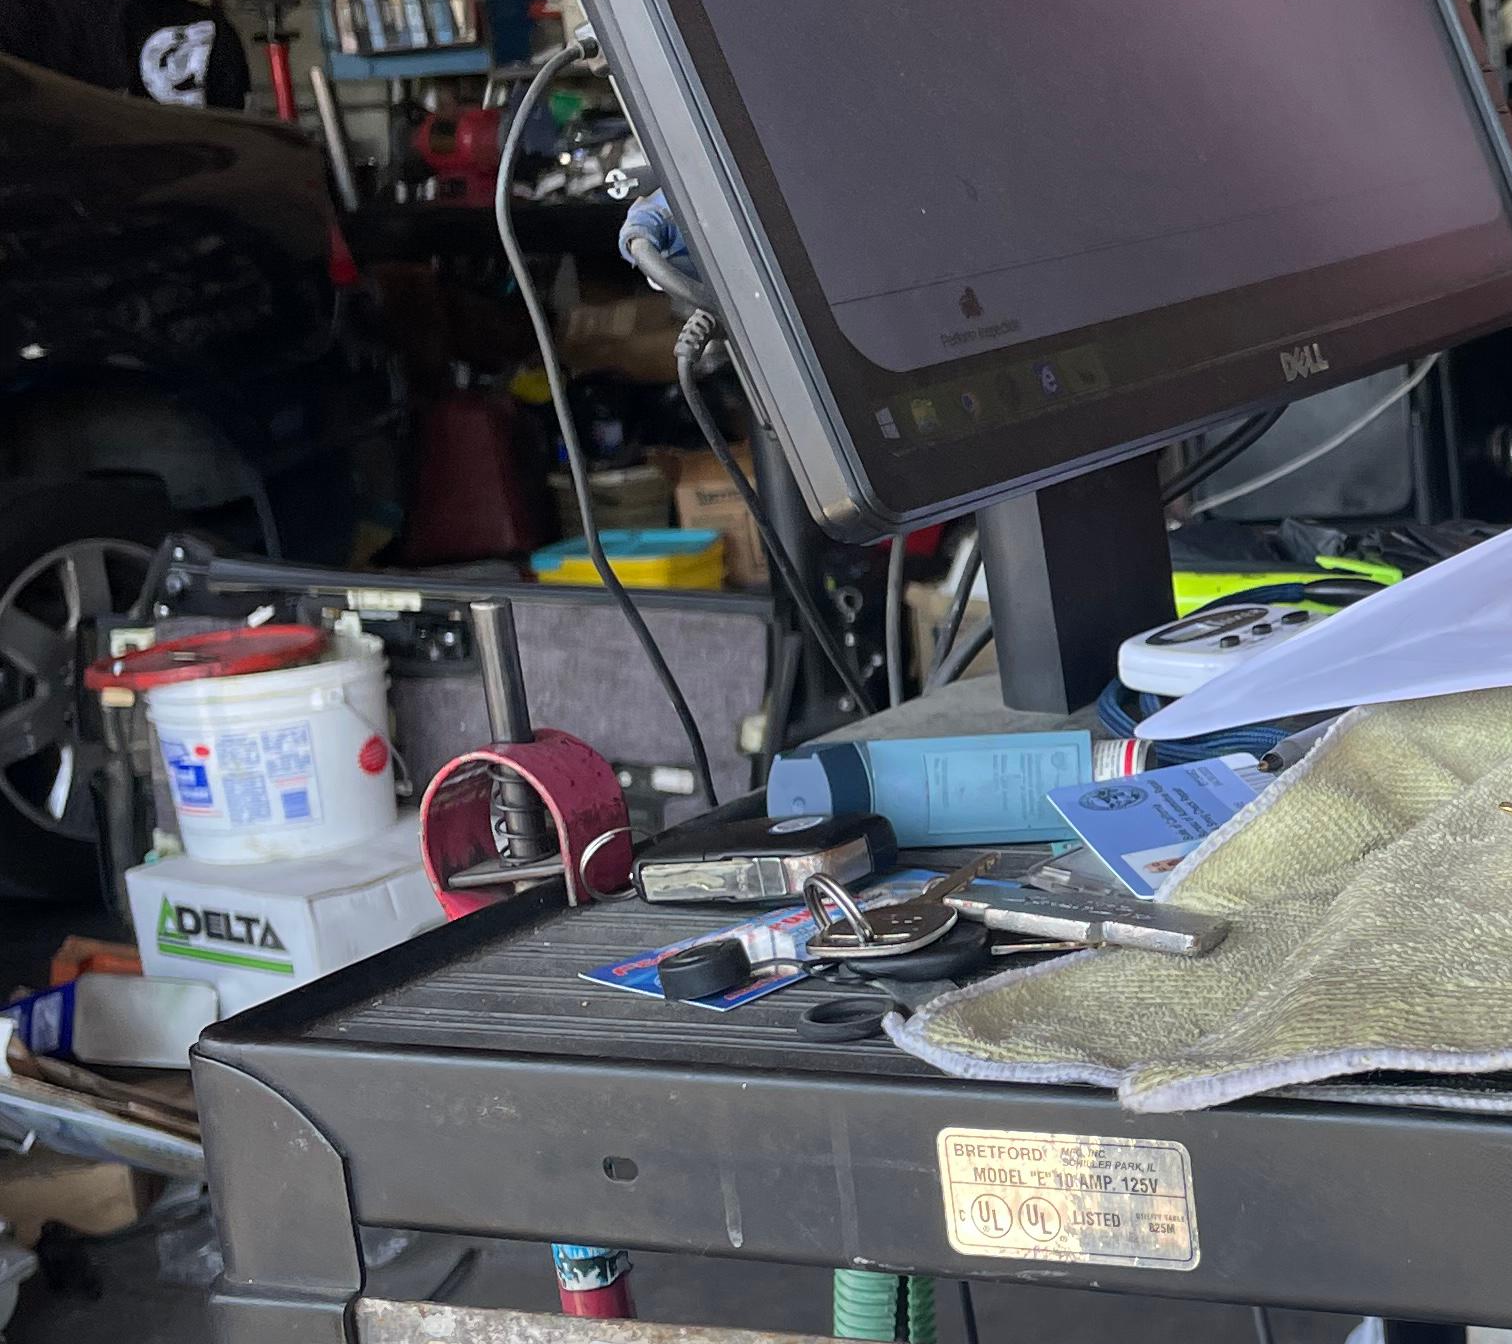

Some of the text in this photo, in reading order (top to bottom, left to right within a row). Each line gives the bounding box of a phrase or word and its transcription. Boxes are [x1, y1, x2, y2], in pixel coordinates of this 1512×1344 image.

[1280, 343, 1329, 382] DELL
[173, 905, 286, 951] DELTA
[954, 1143, 1043, 1161] BRETFORD
[974, 1167, 1025, 1185] MODEL
[1079, 1174, 1116, 1191] AMP.
[1122, 1176, 1158, 1194] 125V
[1073, 1210, 1121, 1228] LISTED
